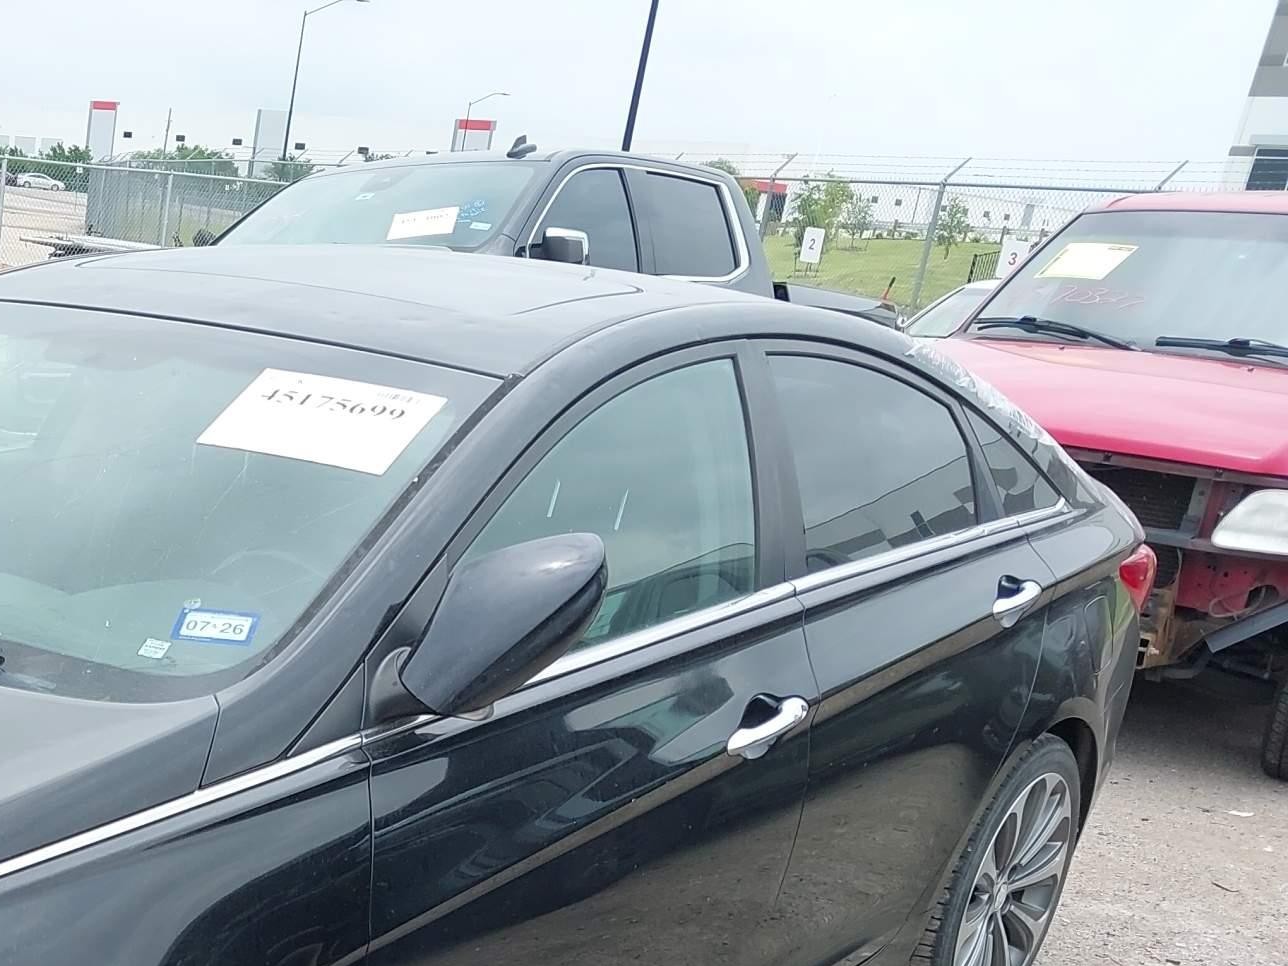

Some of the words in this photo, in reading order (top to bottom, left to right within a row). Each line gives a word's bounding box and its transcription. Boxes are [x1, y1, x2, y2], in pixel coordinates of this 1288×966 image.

[808, 238, 816, 250] 2
[1007, 252, 1018, 266] 3
[261, 388, 406, 420] 45175699
